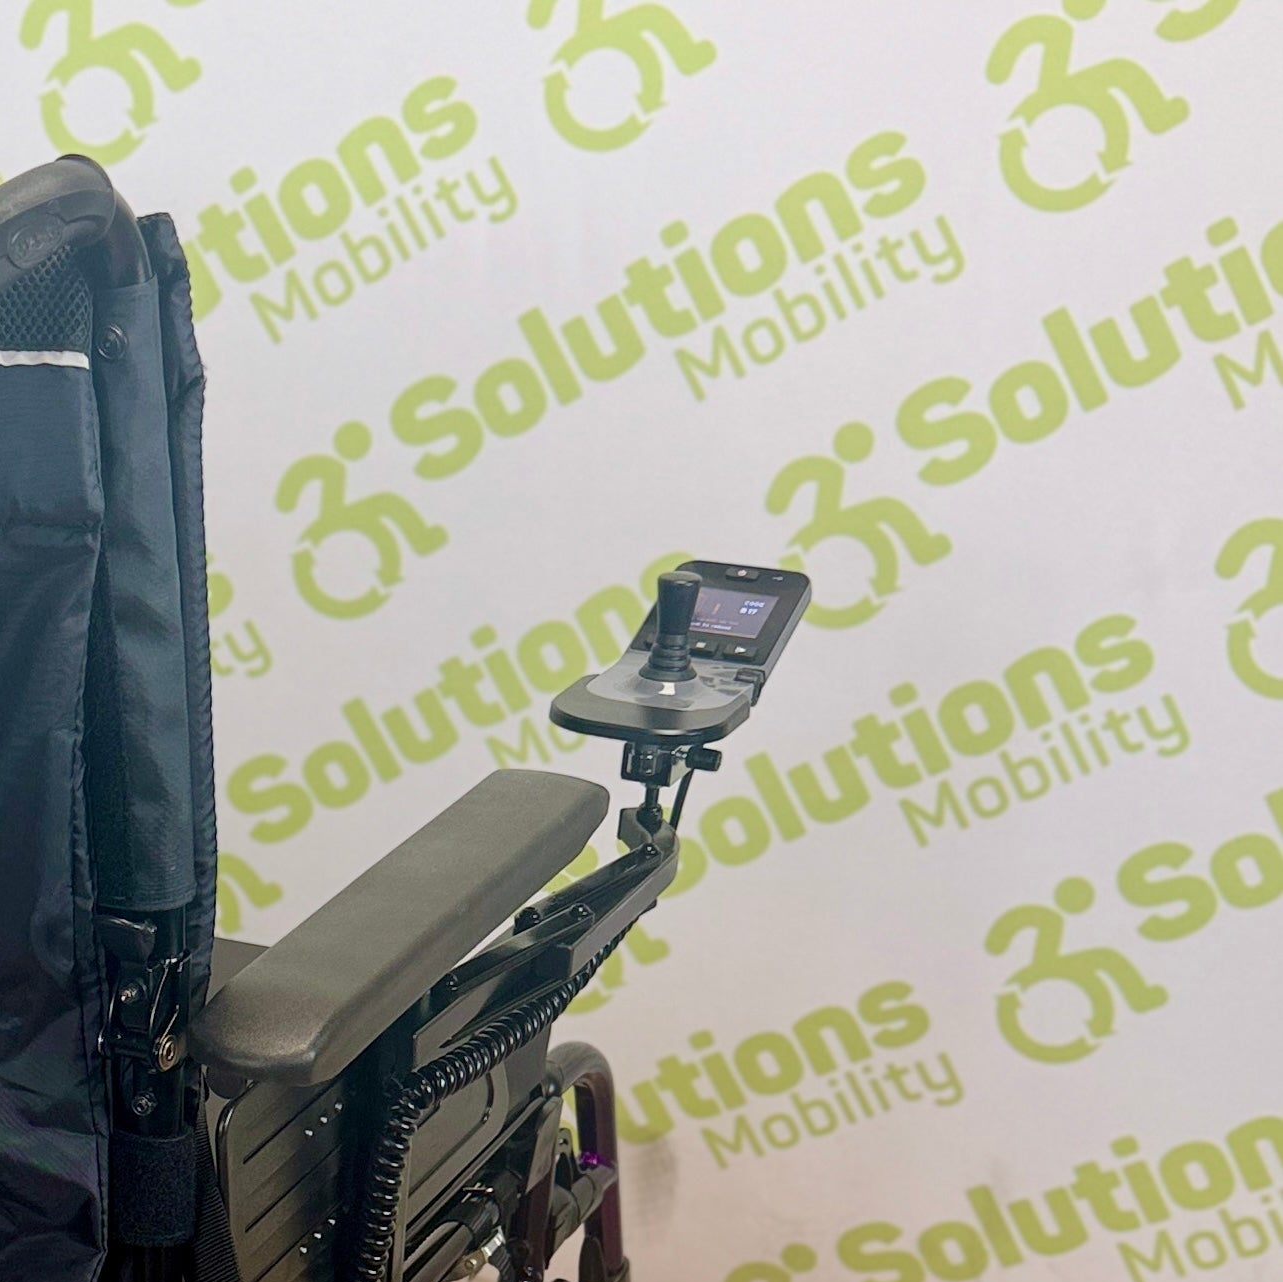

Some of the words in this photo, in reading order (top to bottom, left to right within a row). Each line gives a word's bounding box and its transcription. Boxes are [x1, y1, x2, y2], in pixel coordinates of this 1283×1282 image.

[181, 75, 478, 323] tions
[248, 155, 518, 344] Mobility
[389, 131, 926, 481] Solutions
[674, 215, 966, 402] Mobility
[895, 217, 1283, 487] Soluti
[899, 694, 1191, 847] Mobility
[618, 981, 931, 1145] utions
[700, 1052, 964, 1168] Mobility
